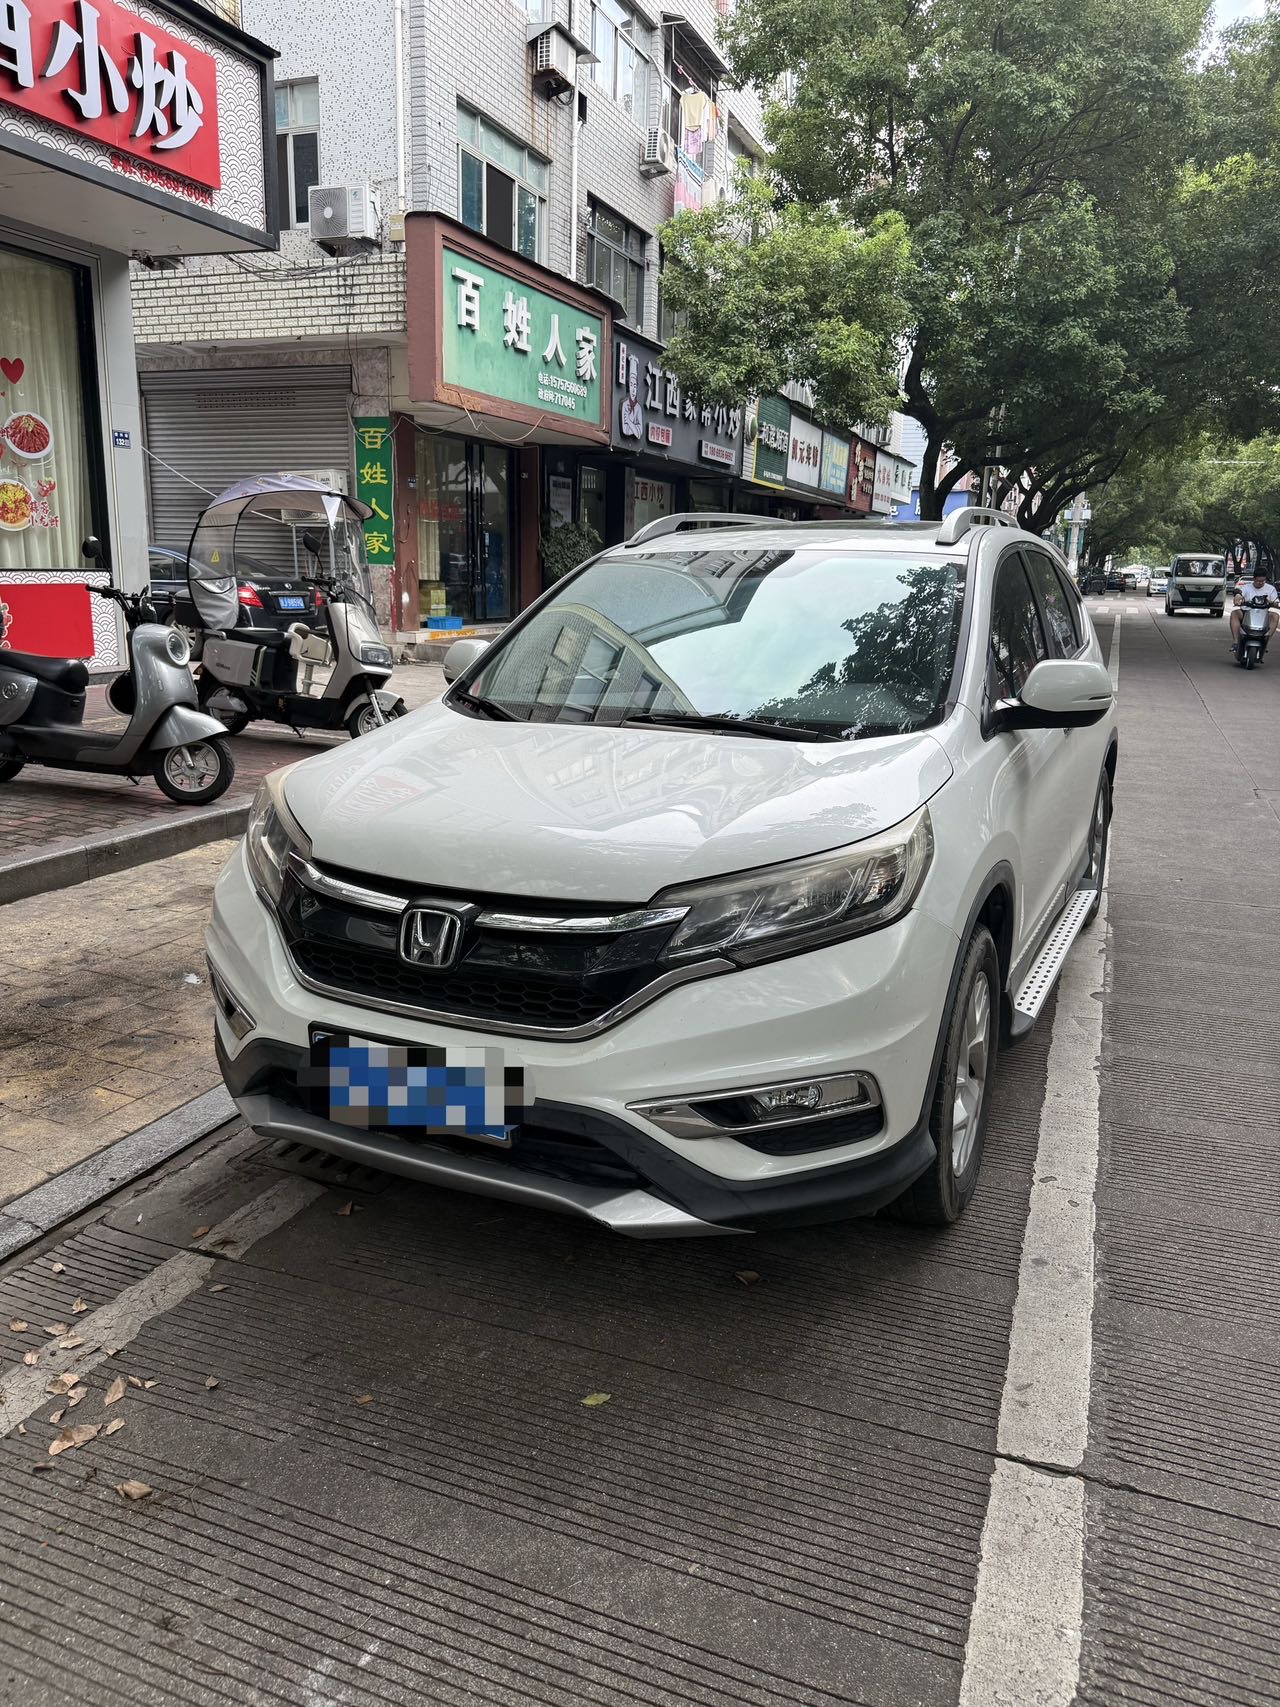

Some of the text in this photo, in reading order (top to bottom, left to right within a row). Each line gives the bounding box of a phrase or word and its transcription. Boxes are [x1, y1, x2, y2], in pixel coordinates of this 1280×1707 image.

[452, 266, 598, 381] 百姓人家
[29, 515, 59, 528] 小龙虾
[359, 427, 391, 554] 百姓人家
